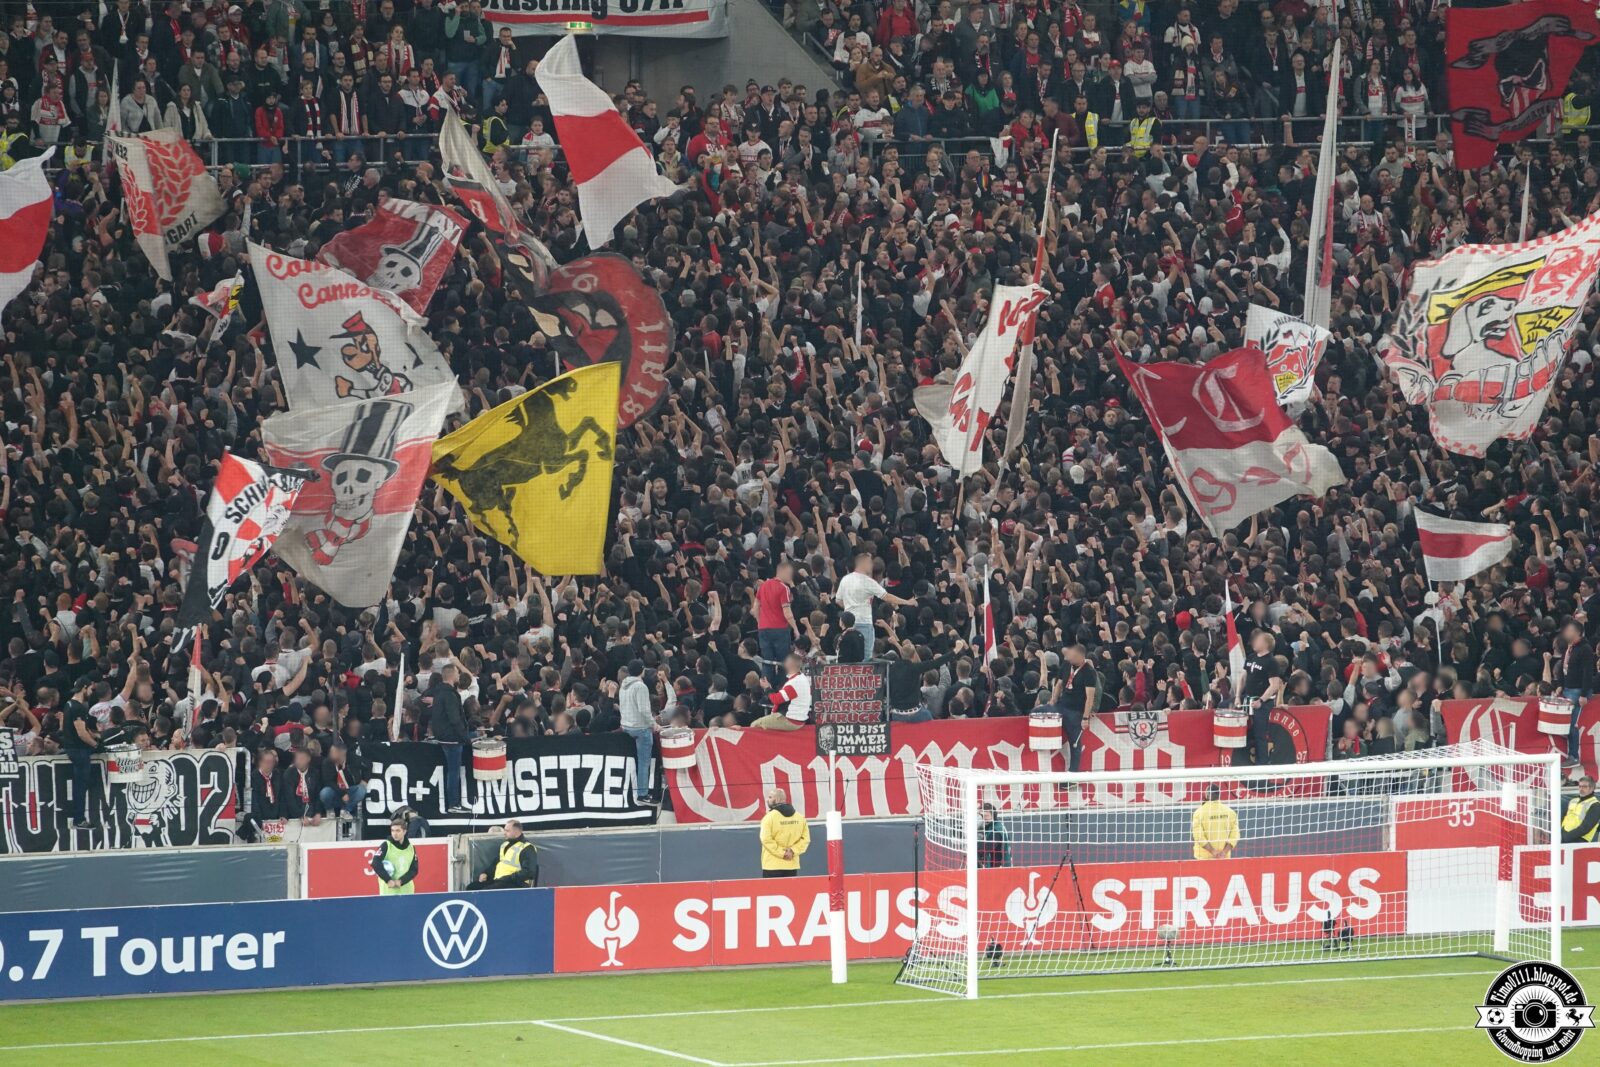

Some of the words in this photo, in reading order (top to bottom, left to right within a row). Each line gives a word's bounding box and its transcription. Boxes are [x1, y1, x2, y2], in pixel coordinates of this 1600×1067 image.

[822, 665, 874, 675] JEDER
[814, 675, 882, 689] VERBANNTE
[821, 689, 876, 700] KEHRT
[1130, 711, 1156, 720] SSV
[837, 724, 854, 734] DU
[859, 723, 886, 734] BIST
[836, 734, 886, 745] IMMER
[837, 745, 855, 754] BEI
[860, 744, 887, 753] UNS!
[366, 762, 447, 816] 50+1
[1447, 801, 1475, 827] 35
[363, 849, 380, 877] 3
[1091, 867, 1383, 933] STRAUSS
[672, 885, 968, 953] STRAUSS
[0, 928, 64, 982] .7
[81, 926, 286, 978] Tourer
